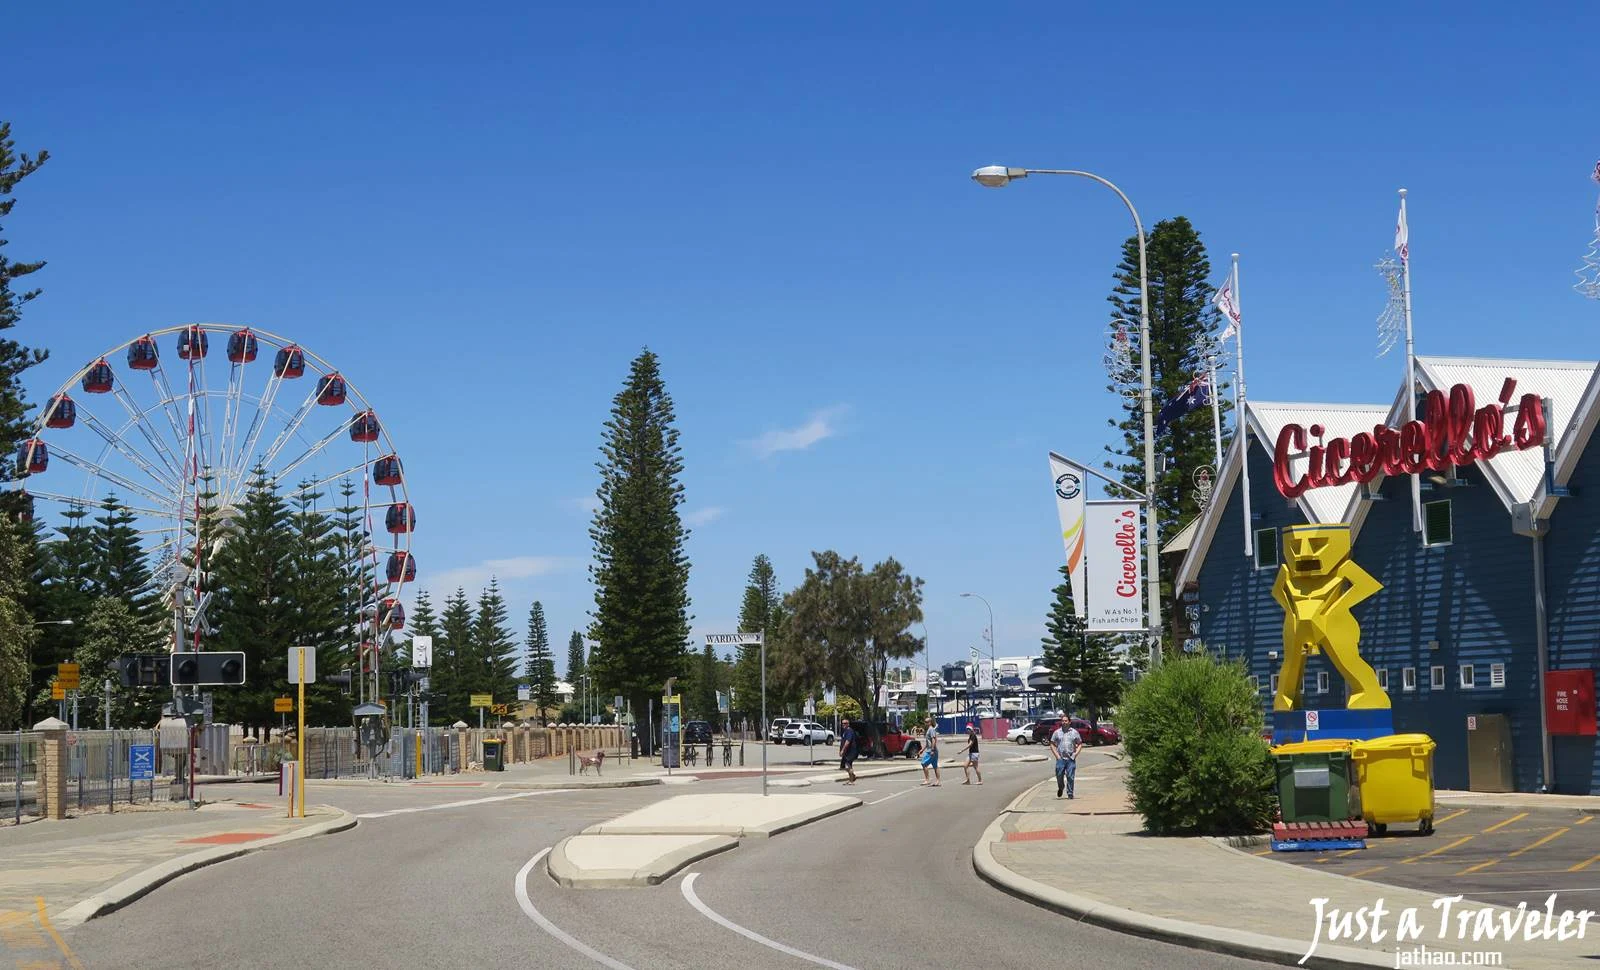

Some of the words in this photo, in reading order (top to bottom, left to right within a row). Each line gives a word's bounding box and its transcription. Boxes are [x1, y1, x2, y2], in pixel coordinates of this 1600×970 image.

[1273, 376, 1547, 500] Cicerello's
[1115, 510, 1137, 598] Cicerello's
[1120, 616, 1138, 624] Chips
[705, 634, 743, 644] WARDAN
[492, 704, 506, 714] 25
